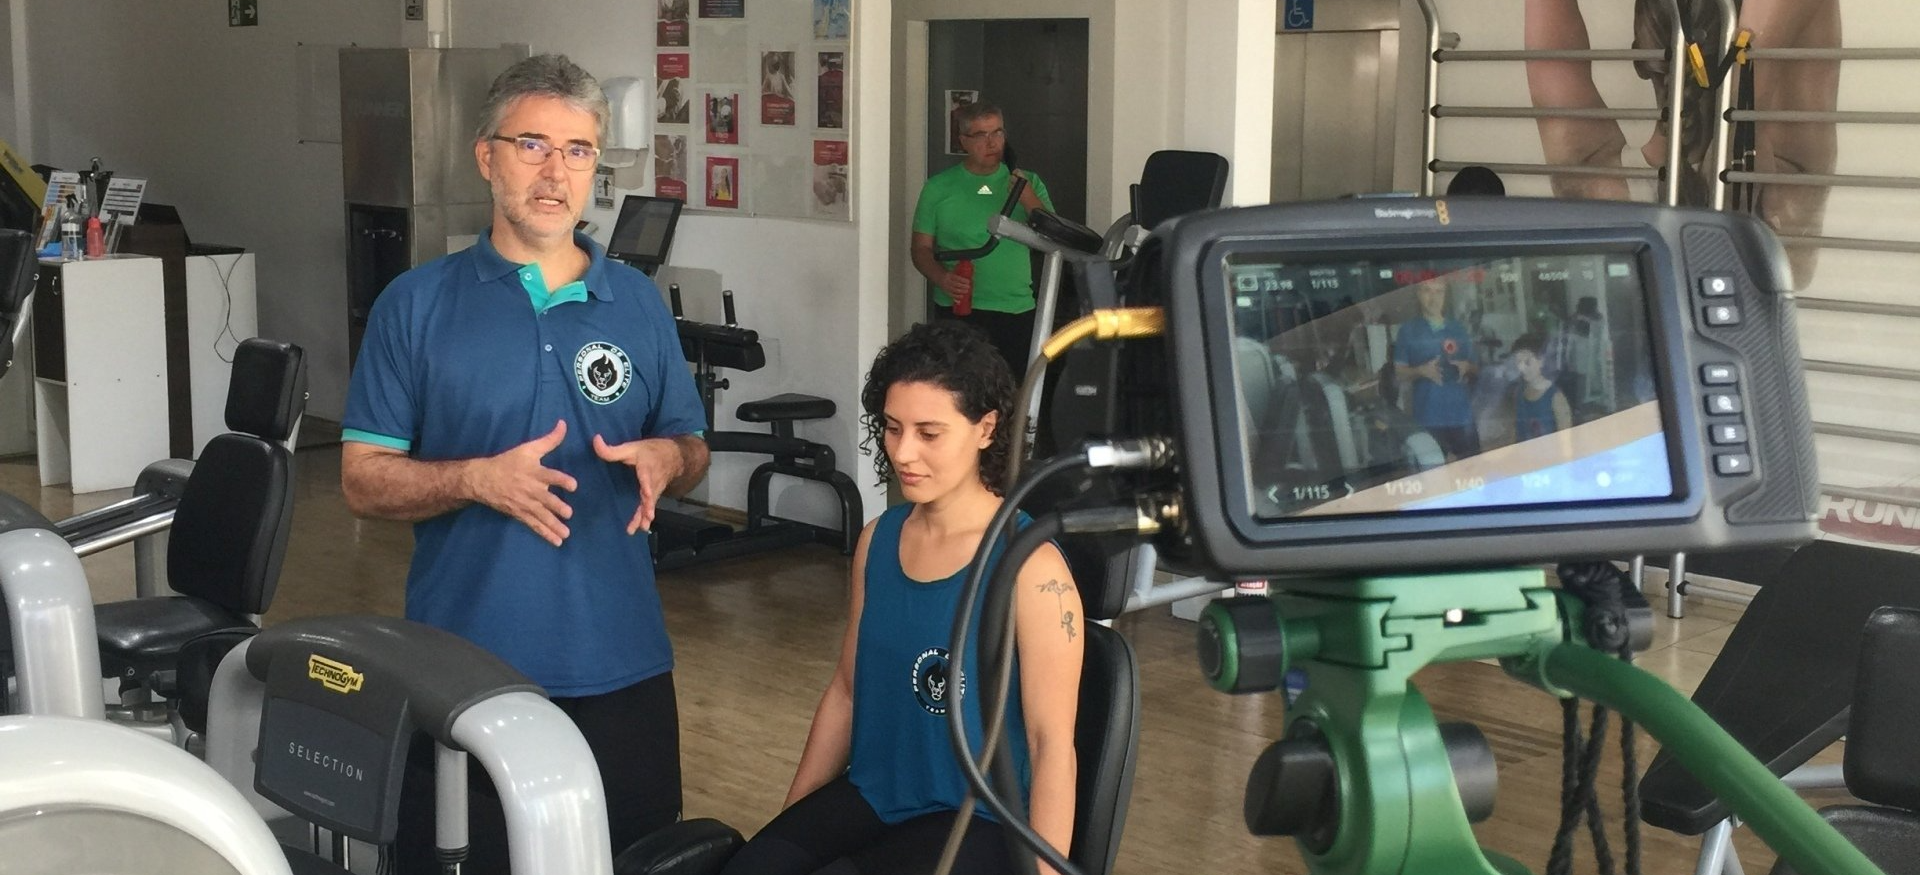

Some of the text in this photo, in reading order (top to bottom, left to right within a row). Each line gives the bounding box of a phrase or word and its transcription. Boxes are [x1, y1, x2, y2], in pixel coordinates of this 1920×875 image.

[1311, 279, 1338, 289] 1/115
[576, 344, 603, 381] PERSONAL
[591, 394, 610, 402] TEAM
[1293, 485, 1330, 499] 1/115
[1384, 481, 1422, 495] 1/120
[1455, 477, 1485, 490] 1/40
[912, 649, 939, 692] PERSONAL
[925, 705, 946, 713] TEAM
[288, 741, 364, 782] SELECTION
